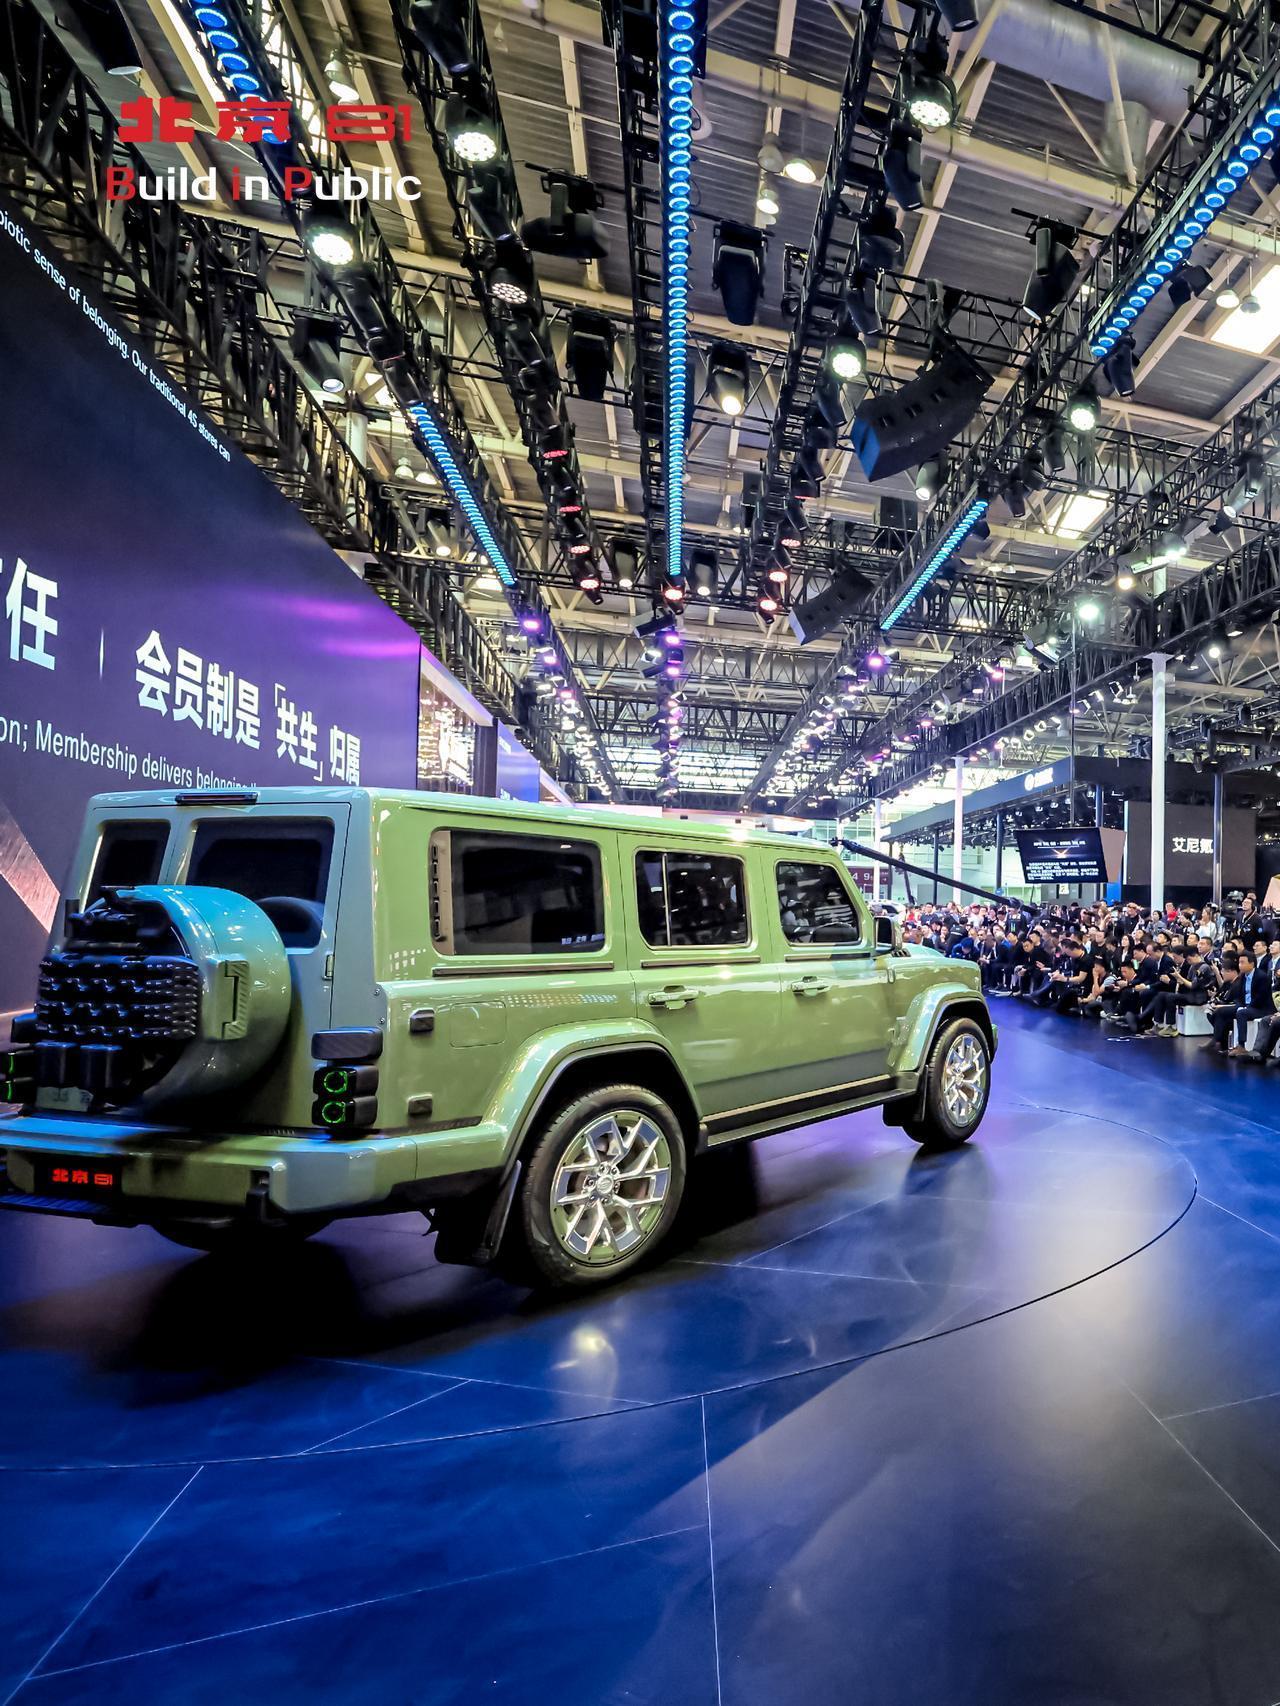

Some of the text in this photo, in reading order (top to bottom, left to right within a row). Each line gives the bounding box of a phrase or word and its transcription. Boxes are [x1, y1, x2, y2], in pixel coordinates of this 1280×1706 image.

[34, 248, 66, 290] sense
[69, 286, 80, 304] of
[82, 295, 129, 358] belonging.
[132, 350, 148, 375] Our
[149, 368, 186, 417] traditional
[199, 423, 218, 450] stores
[219, 444, 231, 462] can
[36, 720, 138, 780] Membership
[142, 752, 193, 788] delivers
